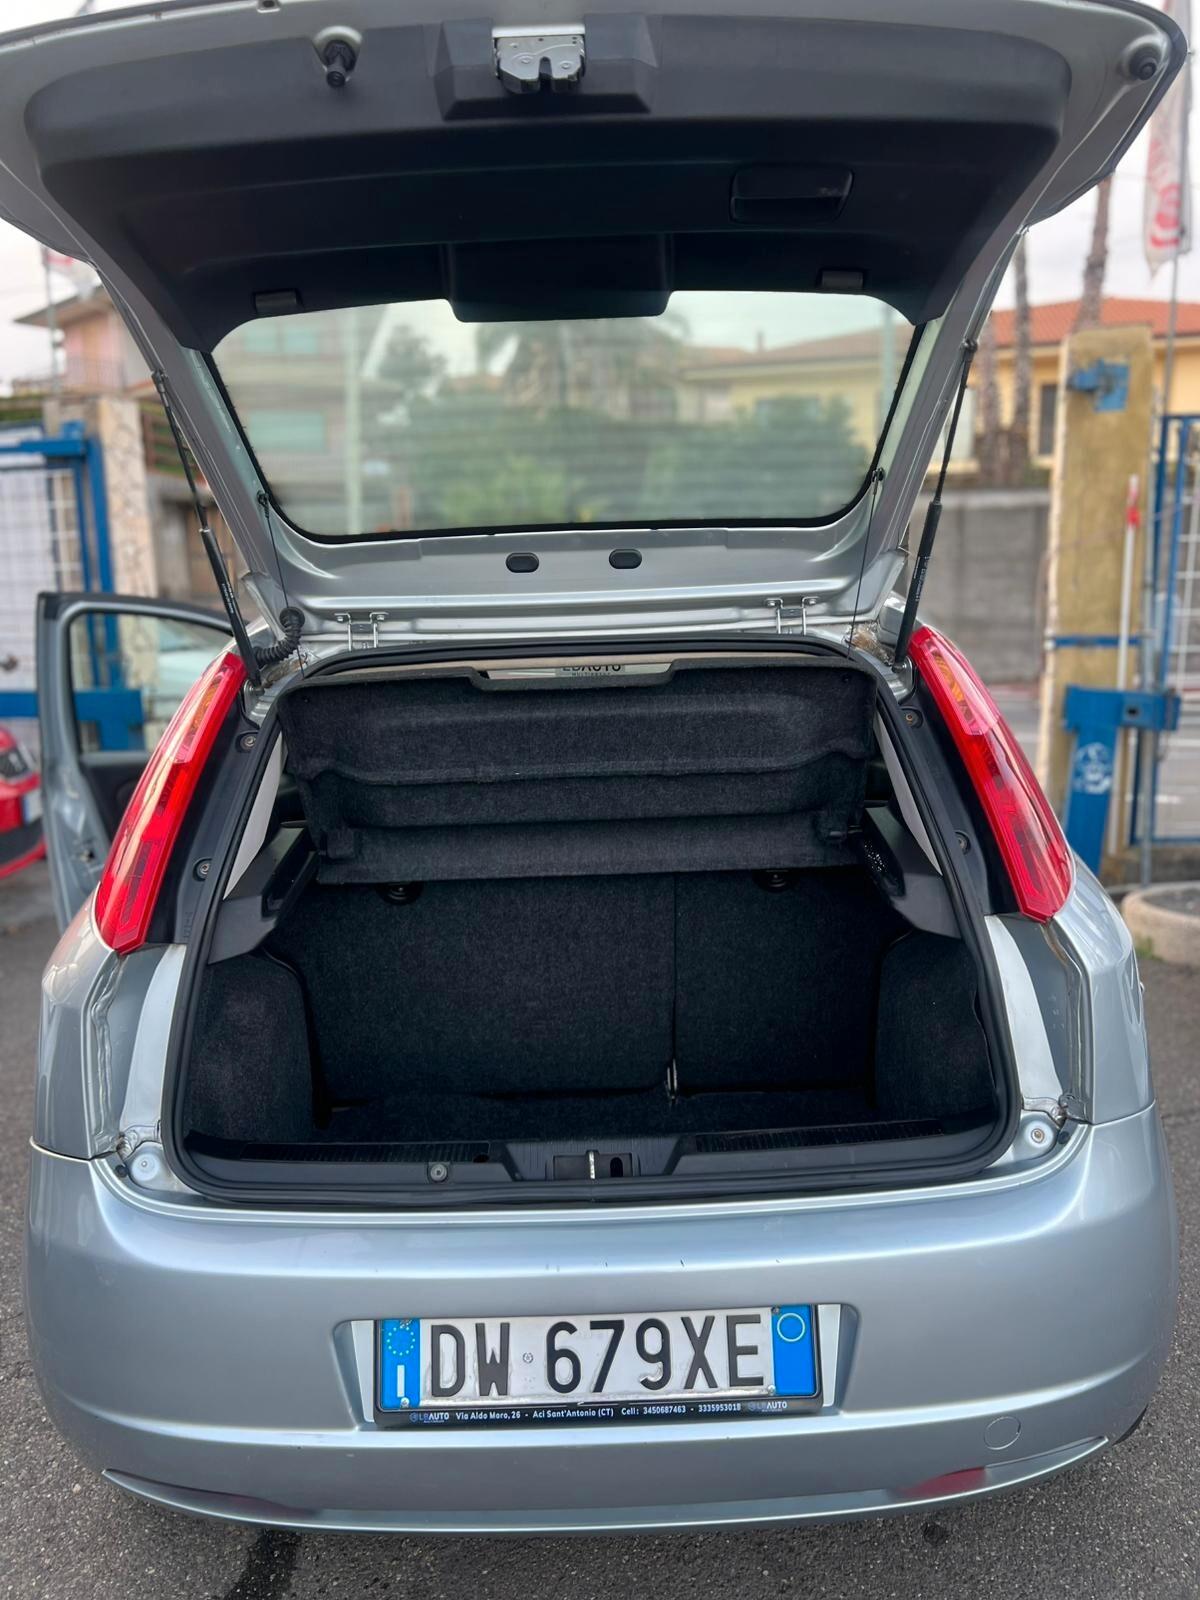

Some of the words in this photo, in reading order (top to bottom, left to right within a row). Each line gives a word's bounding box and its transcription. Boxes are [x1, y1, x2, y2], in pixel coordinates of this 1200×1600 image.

[431, 1322, 510, 1397] DW
[546, 1313, 764, 1394] 679XE
[396, 1364, 405, 1398] I
[455, 1411, 469, 1420] Via
[470, 1411, 488, 1420] Aldo
[533, 1410, 545, 1418] Aci
[547, 1408, 597, 1418] Sant'Antonio
[598, 1408, 614, 1418] (CT)
[621, 1407, 639, 1416] Cell:
